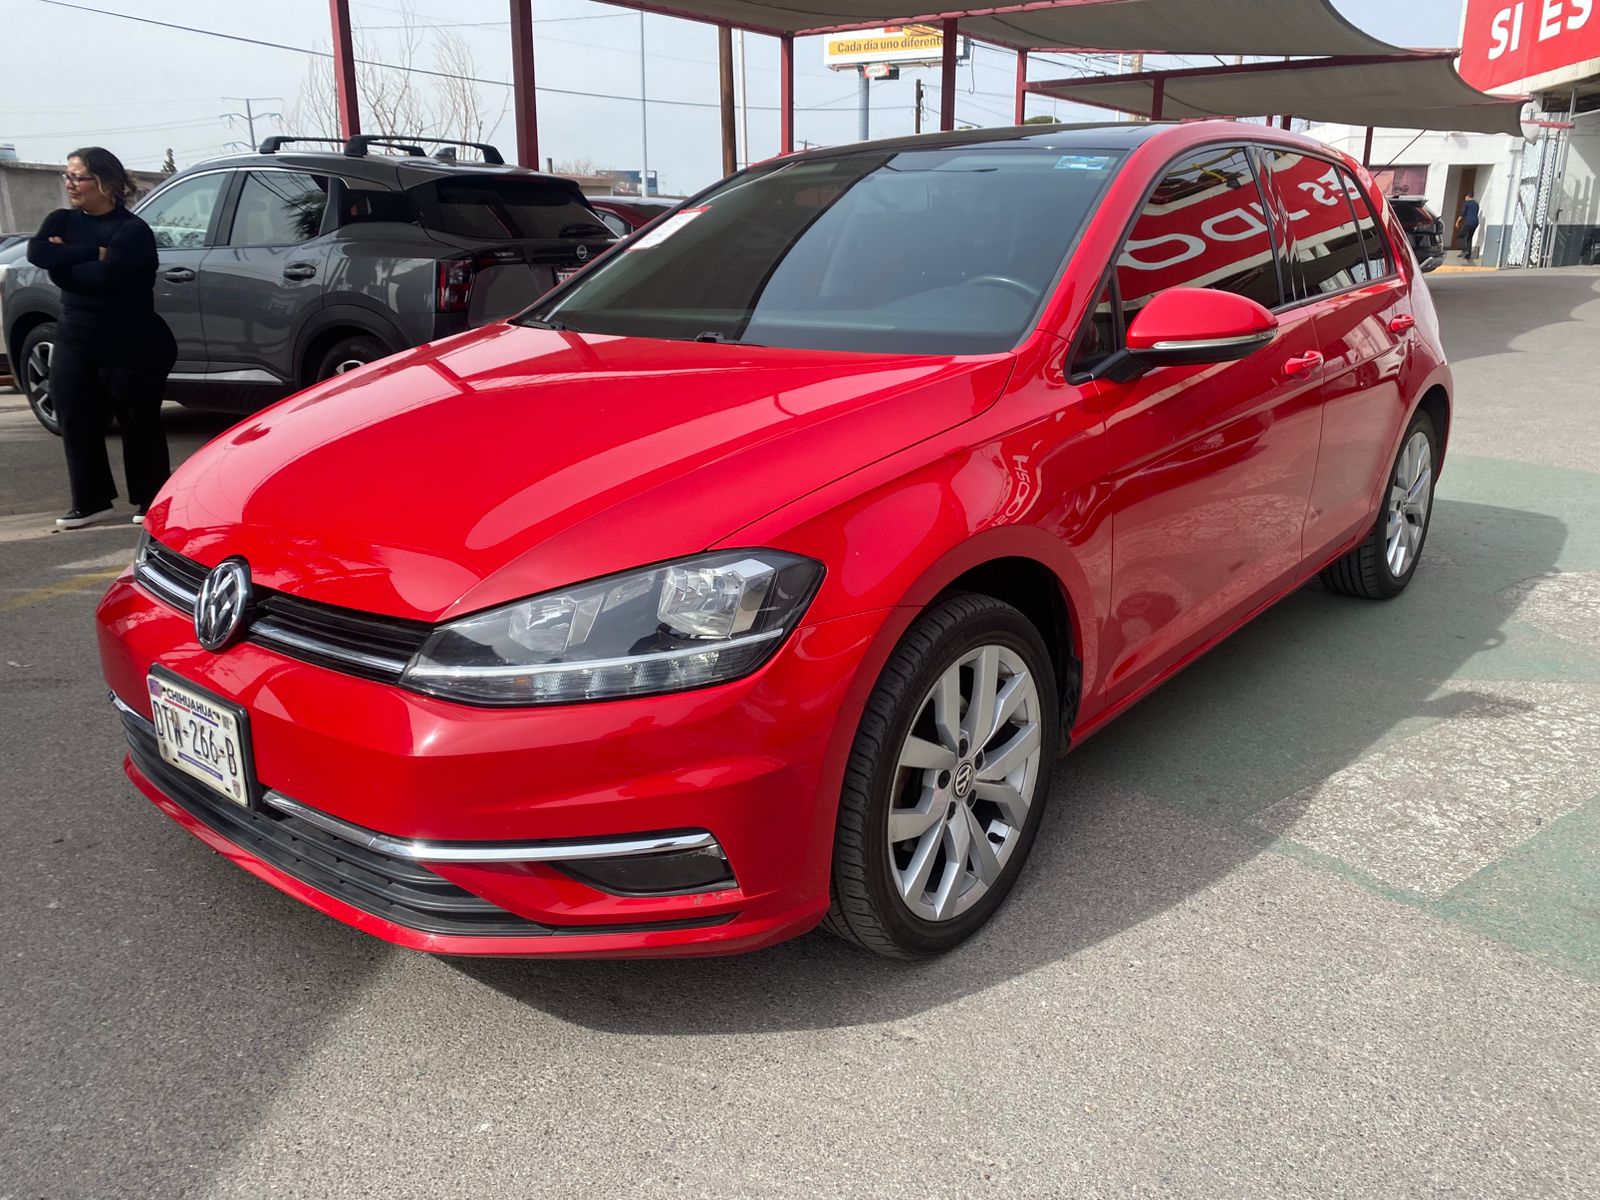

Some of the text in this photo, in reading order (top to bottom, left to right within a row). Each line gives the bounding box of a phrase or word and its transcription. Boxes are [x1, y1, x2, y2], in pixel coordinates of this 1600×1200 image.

[837, 41, 862, 53] Cada
[880, 40, 899, 49] uno
[1487, 2, 1524, 60] SI
[165, 687, 214, 721] CHIHUAHUA
